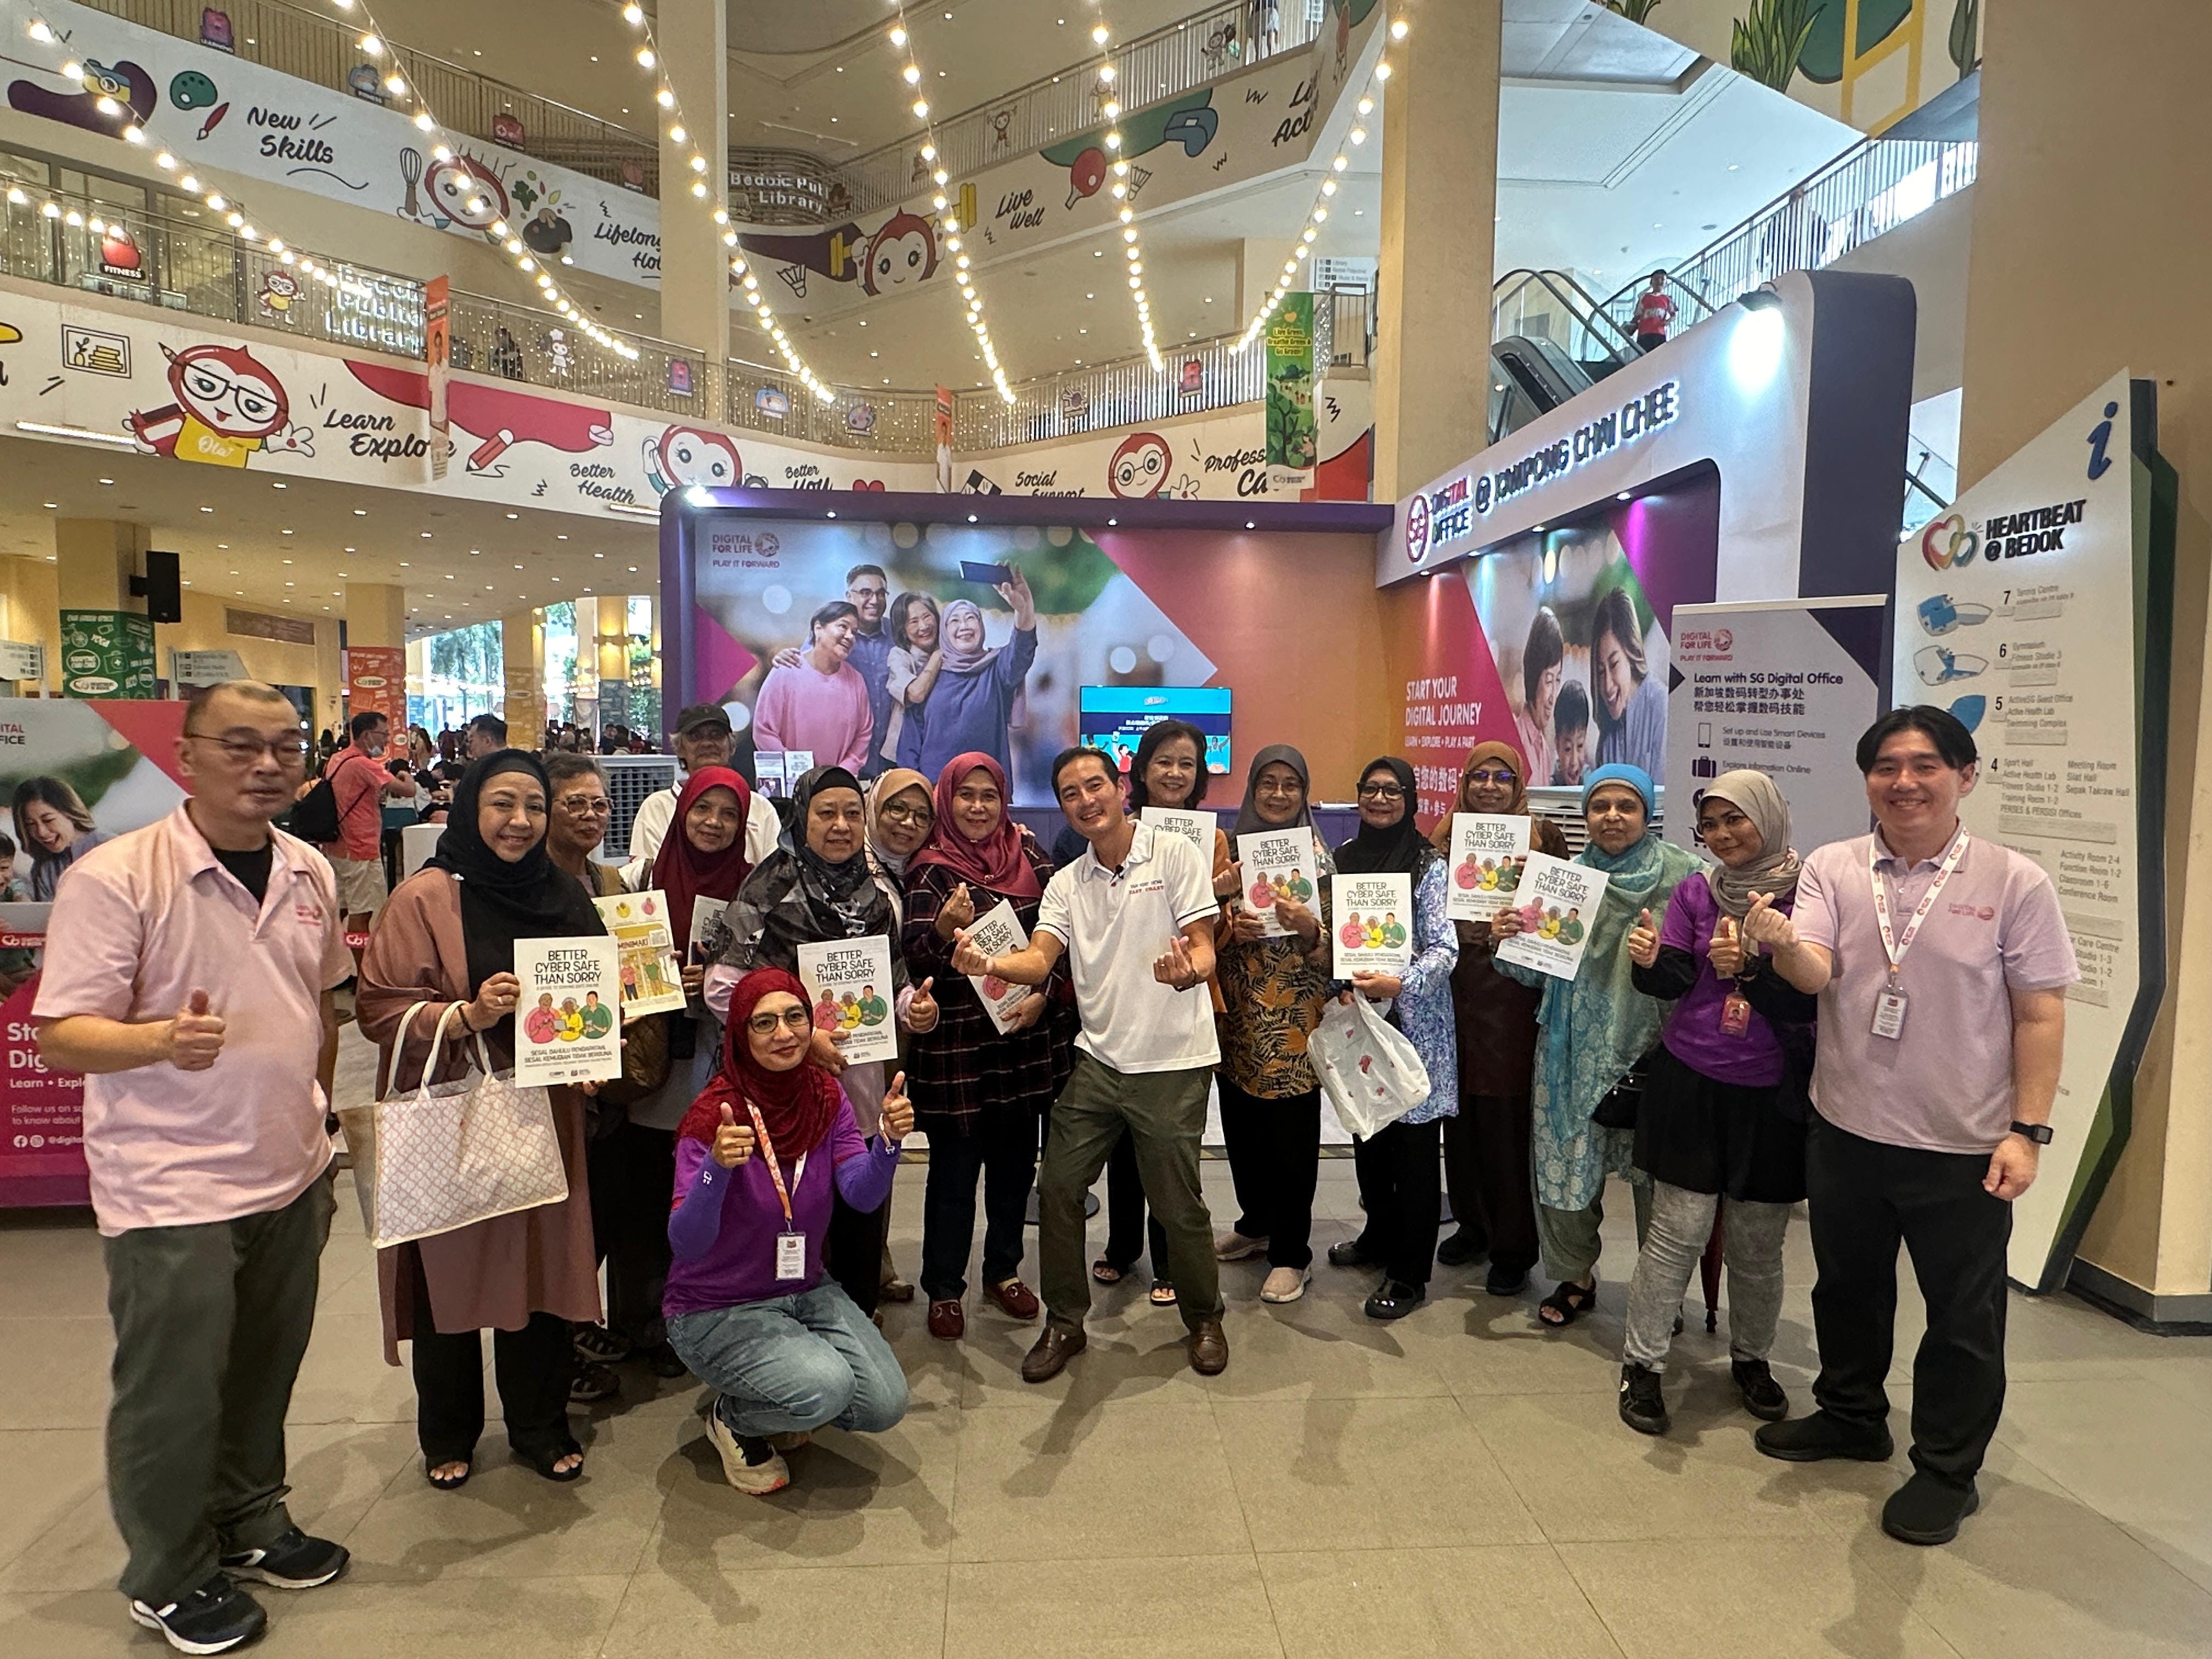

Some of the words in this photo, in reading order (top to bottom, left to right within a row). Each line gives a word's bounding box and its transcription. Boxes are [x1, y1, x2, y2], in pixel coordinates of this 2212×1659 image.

[247, 106, 301, 130] New
[260, 134, 333, 163] Skills
[759, 190, 822, 215] Library
[995, 189, 1034, 219] Live
[1010, 206, 1045, 230] Well
[104, 264, 142, 279] FITNESS
[323, 409, 395, 431] Learn
[1573, 412, 1617, 462] CHAI
[1622, 382, 1676, 439] CHEE
[570, 463, 616, 478] Better
[785, 464, 820, 479] Better
[1015, 470, 1057, 487] Social
[577, 479, 636, 505] Health
[1431, 476, 1471, 515] DIGITAL
[1432, 507, 1471, 544] OFFICE
[1985, 499, 2087, 540] HEARTBEAT
[713, 534, 752, 544] DIGITAL
[1984, 540, 2002, 562] @
[2005, 528, 2065, 559] BEDOK
[713, 544, 731, 553] FOR
[733, 545, 753, 554] LIFE
[742, 560, 780, 568] FORWARD
[2004, 590, 2011, 605] 7
[1680, 632, 1712, 641] DIGITAL
[1696, 641, 1712, 649] LIFE
[1999, 644, 2007, 658] 6
[1694, 673, 1721, 684] Learn
[1724, 672, 1747, 684] with
[1750, 673, 1764, 684] SG
[1768, 672, 1804, 686] Digital
[1807, 672, 1843, 685] Office
[1406, 678, 1431, 702] START
[1432, 676, 1458, 699] YOUR
[1694, 686, 1805, 701] 新加坡数码转型办事处
[1694, 701, 1805, 715] 帮您轻松掌握数码技能
[1995, 696, 2003, 711] 5
[1406, 705, 1436, 727] DIGITAL
[1437, 702, 1482, 726] JOURNEY
[2044, 707, 2055, 715] Lab
[1722, 726, 1733, 735] Set
[1734, 728, 1744, 736] up
[1745, 728, 1759, 736] and
[1773, 729, 1796, 738] Smart
[1797, 730, 1826, 740] Devices
[1786, 763, 1812, 774] Online
[1990, 757, 1998, 772] 4
[2004, 758, 2020, 768] Sport
[2067, 760, 2095, 771] Meeting
[2096, 760, 2117, 770] Room
[2003, 770, 2021, 778] Active
[2023, 771, 2043, 780] Health
[2044, 771, 2056, 780] Lab
[2084, 772, 2097, 782] Hall
[2002, 781, 2024, 791] Fitness
[2025, 782, 2045, 792] Studio
[2066, 784, 2087, 795] Sepak
[2088, 786, 2114, 796] Takraw
[2115, 787, 2130, 797] Hall
[2001, 793, 2025, 804] Training
[2027, 794, 2045, 803] Room
[1164, 817, 1194, 827] BETTER
[1476, 822, 1506, 832] BETTER
[1182, 827, 1202, 836] SAFE
[1466, 830, 1492, 839] CYBER
[1493, 832, 1516, 842] SAFE
[1260, 838, 1289, 849] BETTER
[1464, 838, 1487, 848] THAN
[1488, 840, 1516, 850] SORRY
[1252, 848, 1278, 859] CYBER
[1279, 845, 1300, 856] SAFE
[2060, 850, 2085, 861] Activity
[2086, 852, 2107, 863] Room
[1252, 859, 1274, 867] THAN
[1275, 854, 1301, 865] SORRY
[1550, 866, 1582, 882] BETTER
[2059, 861, 2087, 874] Function
[2089, 864, 2109, 877] Room
[1356, 882, 1387, 890] BETTER
[1537, 872, 1566, 886] CYBER
[1567, 881, 1589, 895] SAFE
[2058, 873, 2095, 887] Classroom
[1346, 890, 1374, 899] CYBER
[1375, 890, 1397, 898] SAFE
[1534, 880, 1558, 895] THAN
[1558, 888, 1588, 904] SORRY
[2058, 886, 2096, 900] Conference
[2098, 891, 2119, 904] Room
[1346, 899, 1368, 907] THAN
[1370, 898, 1398, 906] SORRY
[973, 919, 998, 944] BETTER
[991, 922, 1008, 939] SAFE
[992, 930, 1013, 950] SORRY
[2077, 936, 2094, 948] Care
[2096, 940, 2120, 953] Centre
[548, 949, 588, 961] BETTER
[827, 950, 862, 962] BETTER
[535, 962, 571, 973] CYBER
[573, 960, 600, 971] SAFE
[816, 961, 847, 973] CYBER
[849, 958, 874, 970] SAFE
[534, 973, 564, 985] THAN
[566, 972, 602, 984] SORRY
[815, 972, 843, 984] THAN
[844, 968, 876, 980] SORRY
[10, 1078, 44, 1088] Learn
[11, 1104, 43, 1114] Follow
[12, 1117, 22, 1125] to
[24, 1116, 51, 1125] know
[52, 1116, 81, 1125] about
